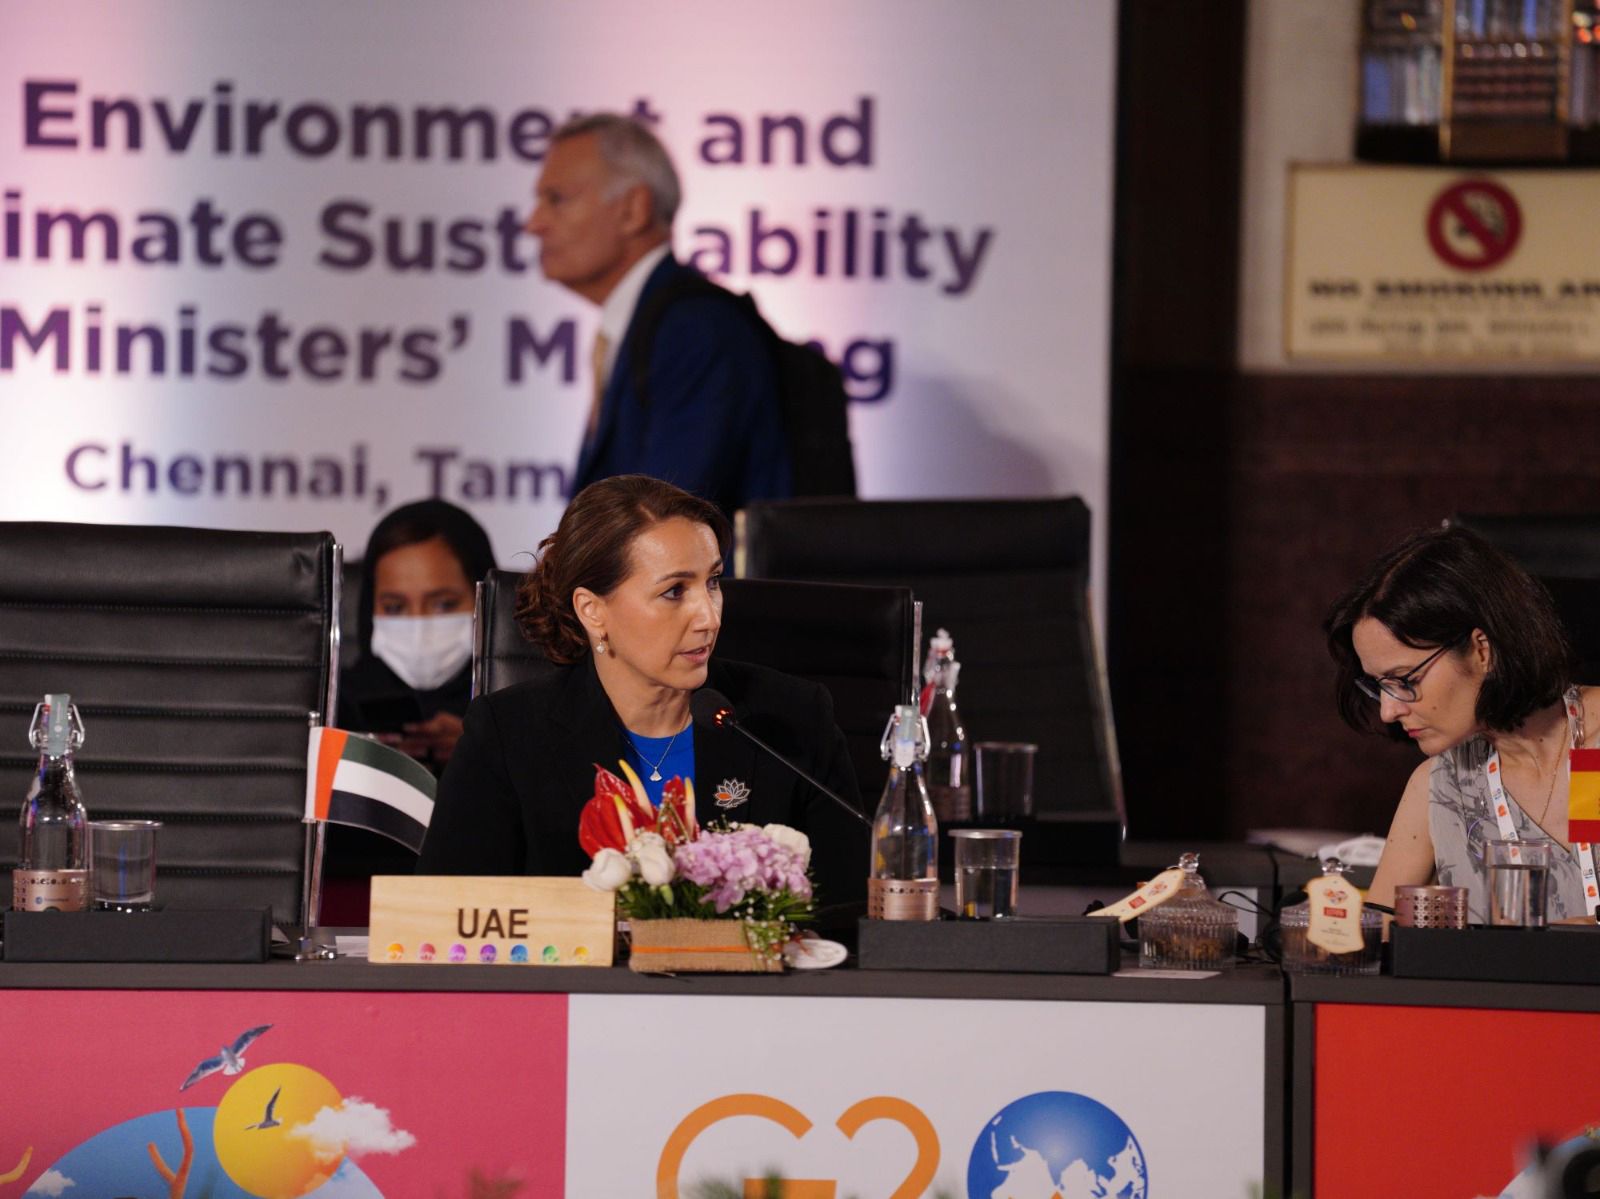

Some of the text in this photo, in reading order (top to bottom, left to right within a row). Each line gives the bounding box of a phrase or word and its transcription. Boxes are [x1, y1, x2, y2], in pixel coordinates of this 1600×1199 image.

[23, 80, 875, 167] Environme and
[318, 200, 993, 296] Sustability
[66, 444, 568, 506] Chennai, Tam
[457, 907, 529, 940] UAE
